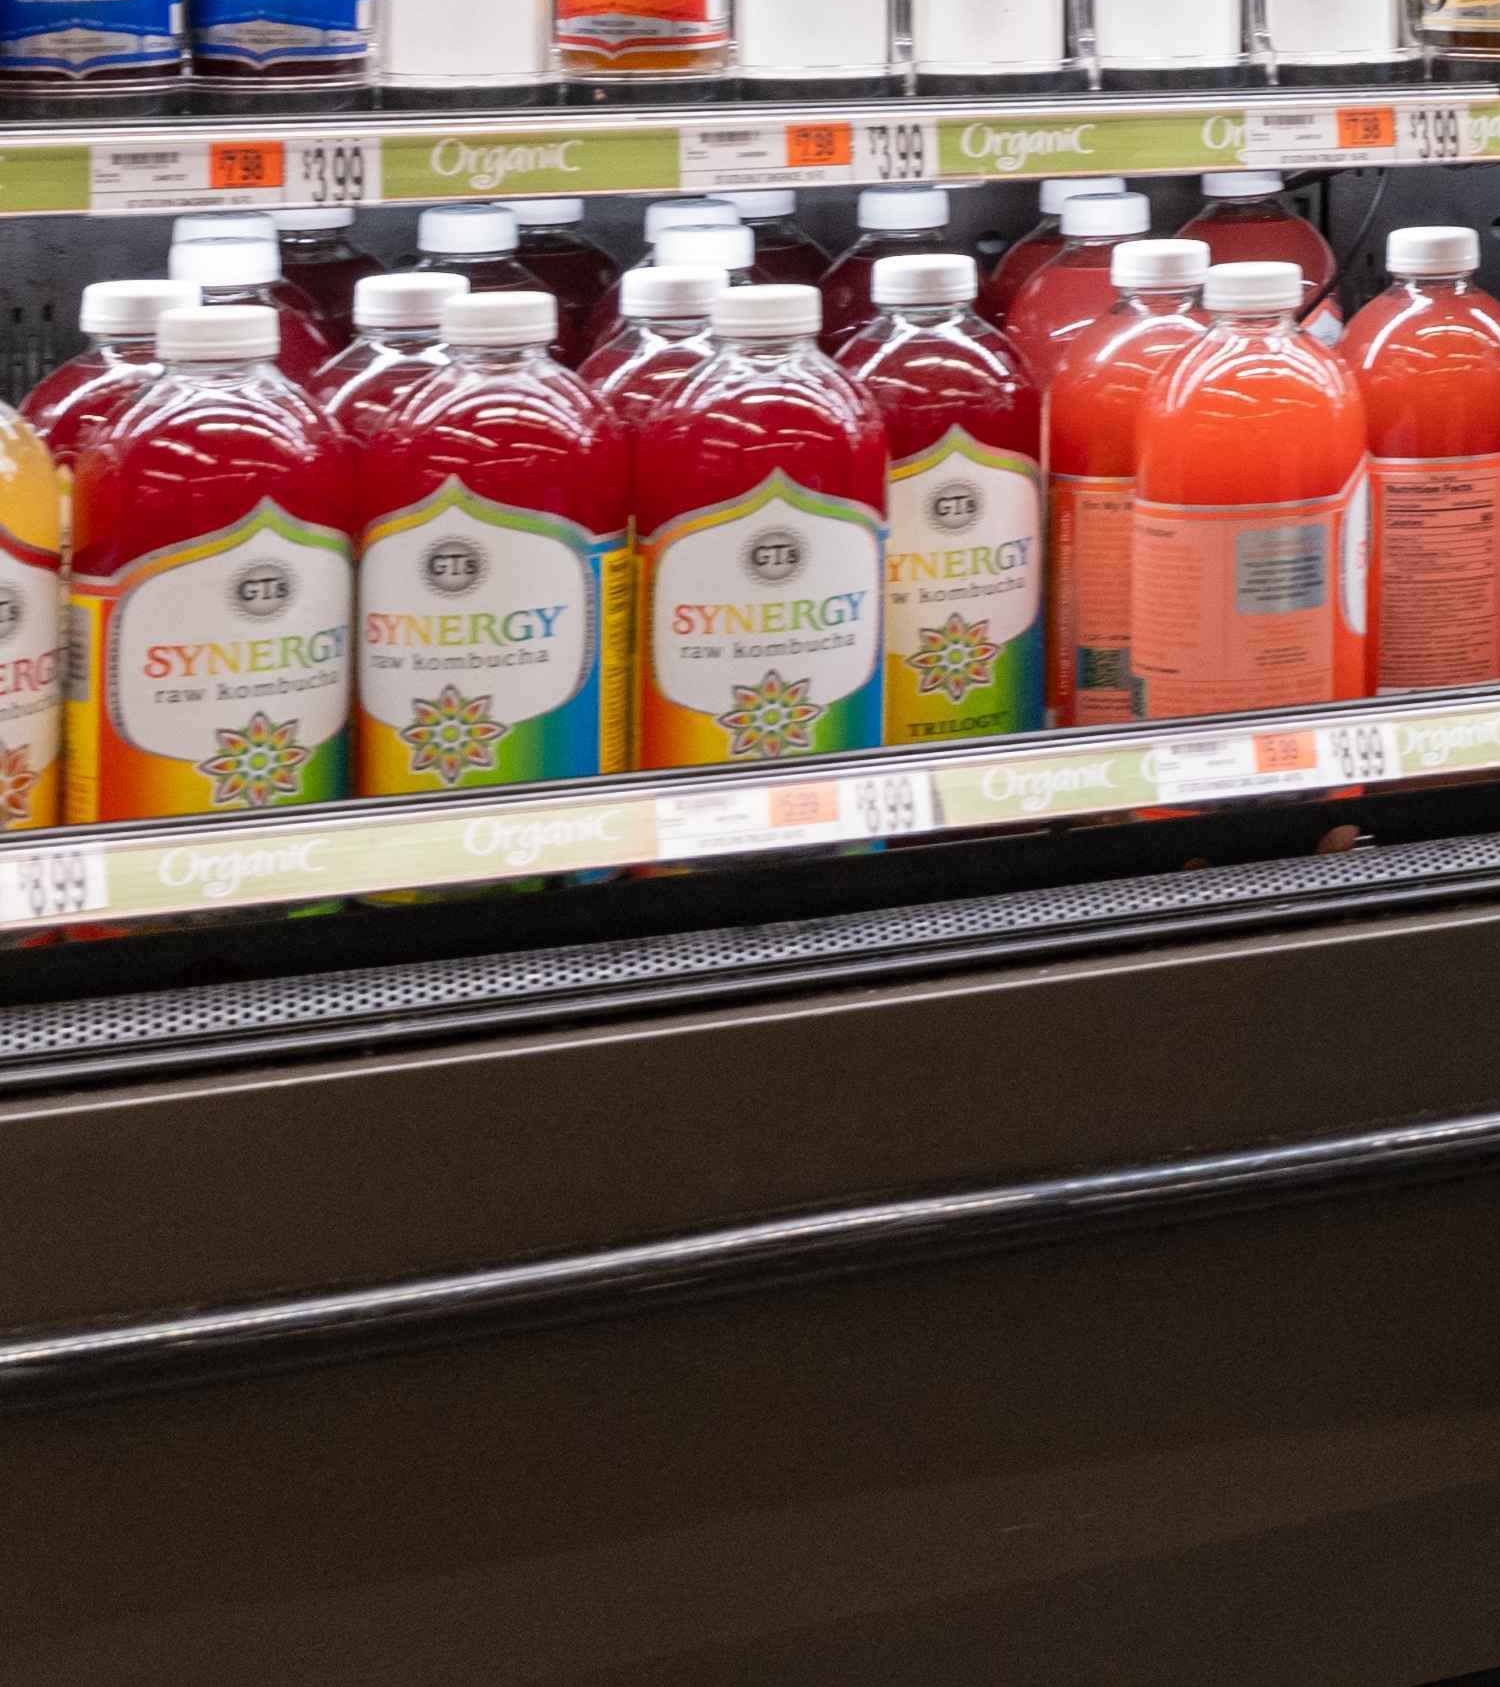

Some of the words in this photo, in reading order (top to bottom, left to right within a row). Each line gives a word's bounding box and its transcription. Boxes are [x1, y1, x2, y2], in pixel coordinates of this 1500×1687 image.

[431, 138, 583, 190] Organic
[961, 121, 1095, 169] Organic
[888, 536, 1034, 581] YNERGY
[919, 574, 1024, 605] kombucha
[368, 606, 568, 647] SYNERGY
[672, 591, 868, 638] SYNERGY
[143, 625, 347, 680] SYNERGY
[369, 654, 402, 669] raw
[411, 648, 550, 672] kombucha
[681, 642, 726, 660] raw
[733, 628, 856, 660] kombucha
[153, 685, 207, 705] raw
[217, 666, 342, 700] kombucha
[982, 756, 1119, 813] Organic
[464, 808, 629, 864] Organic
[160, 839, 326, 899] Organic
